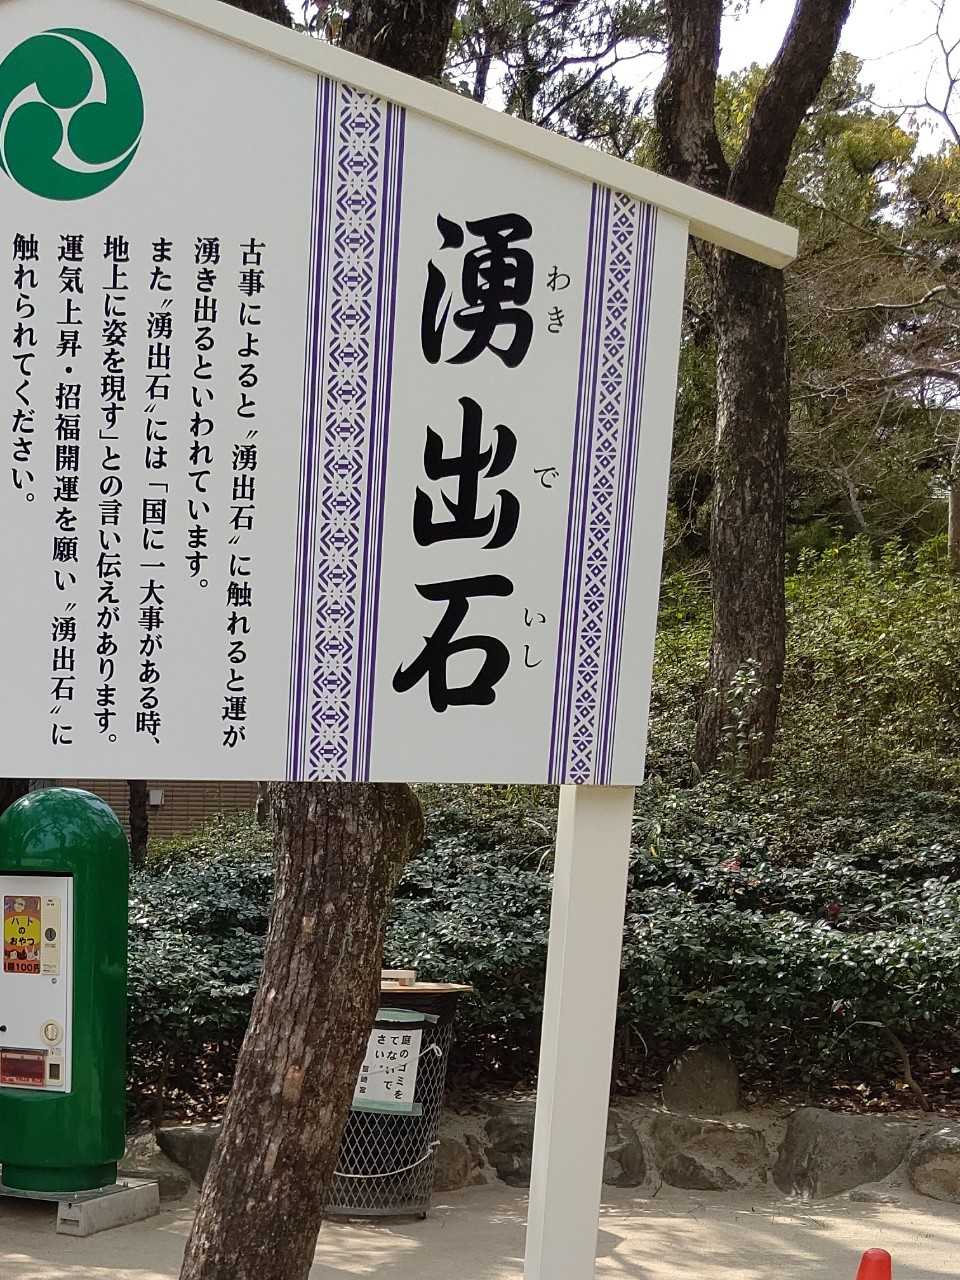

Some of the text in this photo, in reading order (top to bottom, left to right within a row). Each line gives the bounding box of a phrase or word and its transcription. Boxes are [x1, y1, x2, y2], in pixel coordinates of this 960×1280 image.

[12, 233, 40, 503] 触れられてください。
[546, 265, 571, 333] わき
[94, 235, 130, 743] 地上に姿を現す」との言い伝えがあります。
[185, 237, 220, 588] 湧き出るといわれています。
[393, 213, 534, 713] 湧出石
[533, 467, 560, 489] で
[523, 608, 547, 668] いし
[10, 937, 35, 946] おやつ
